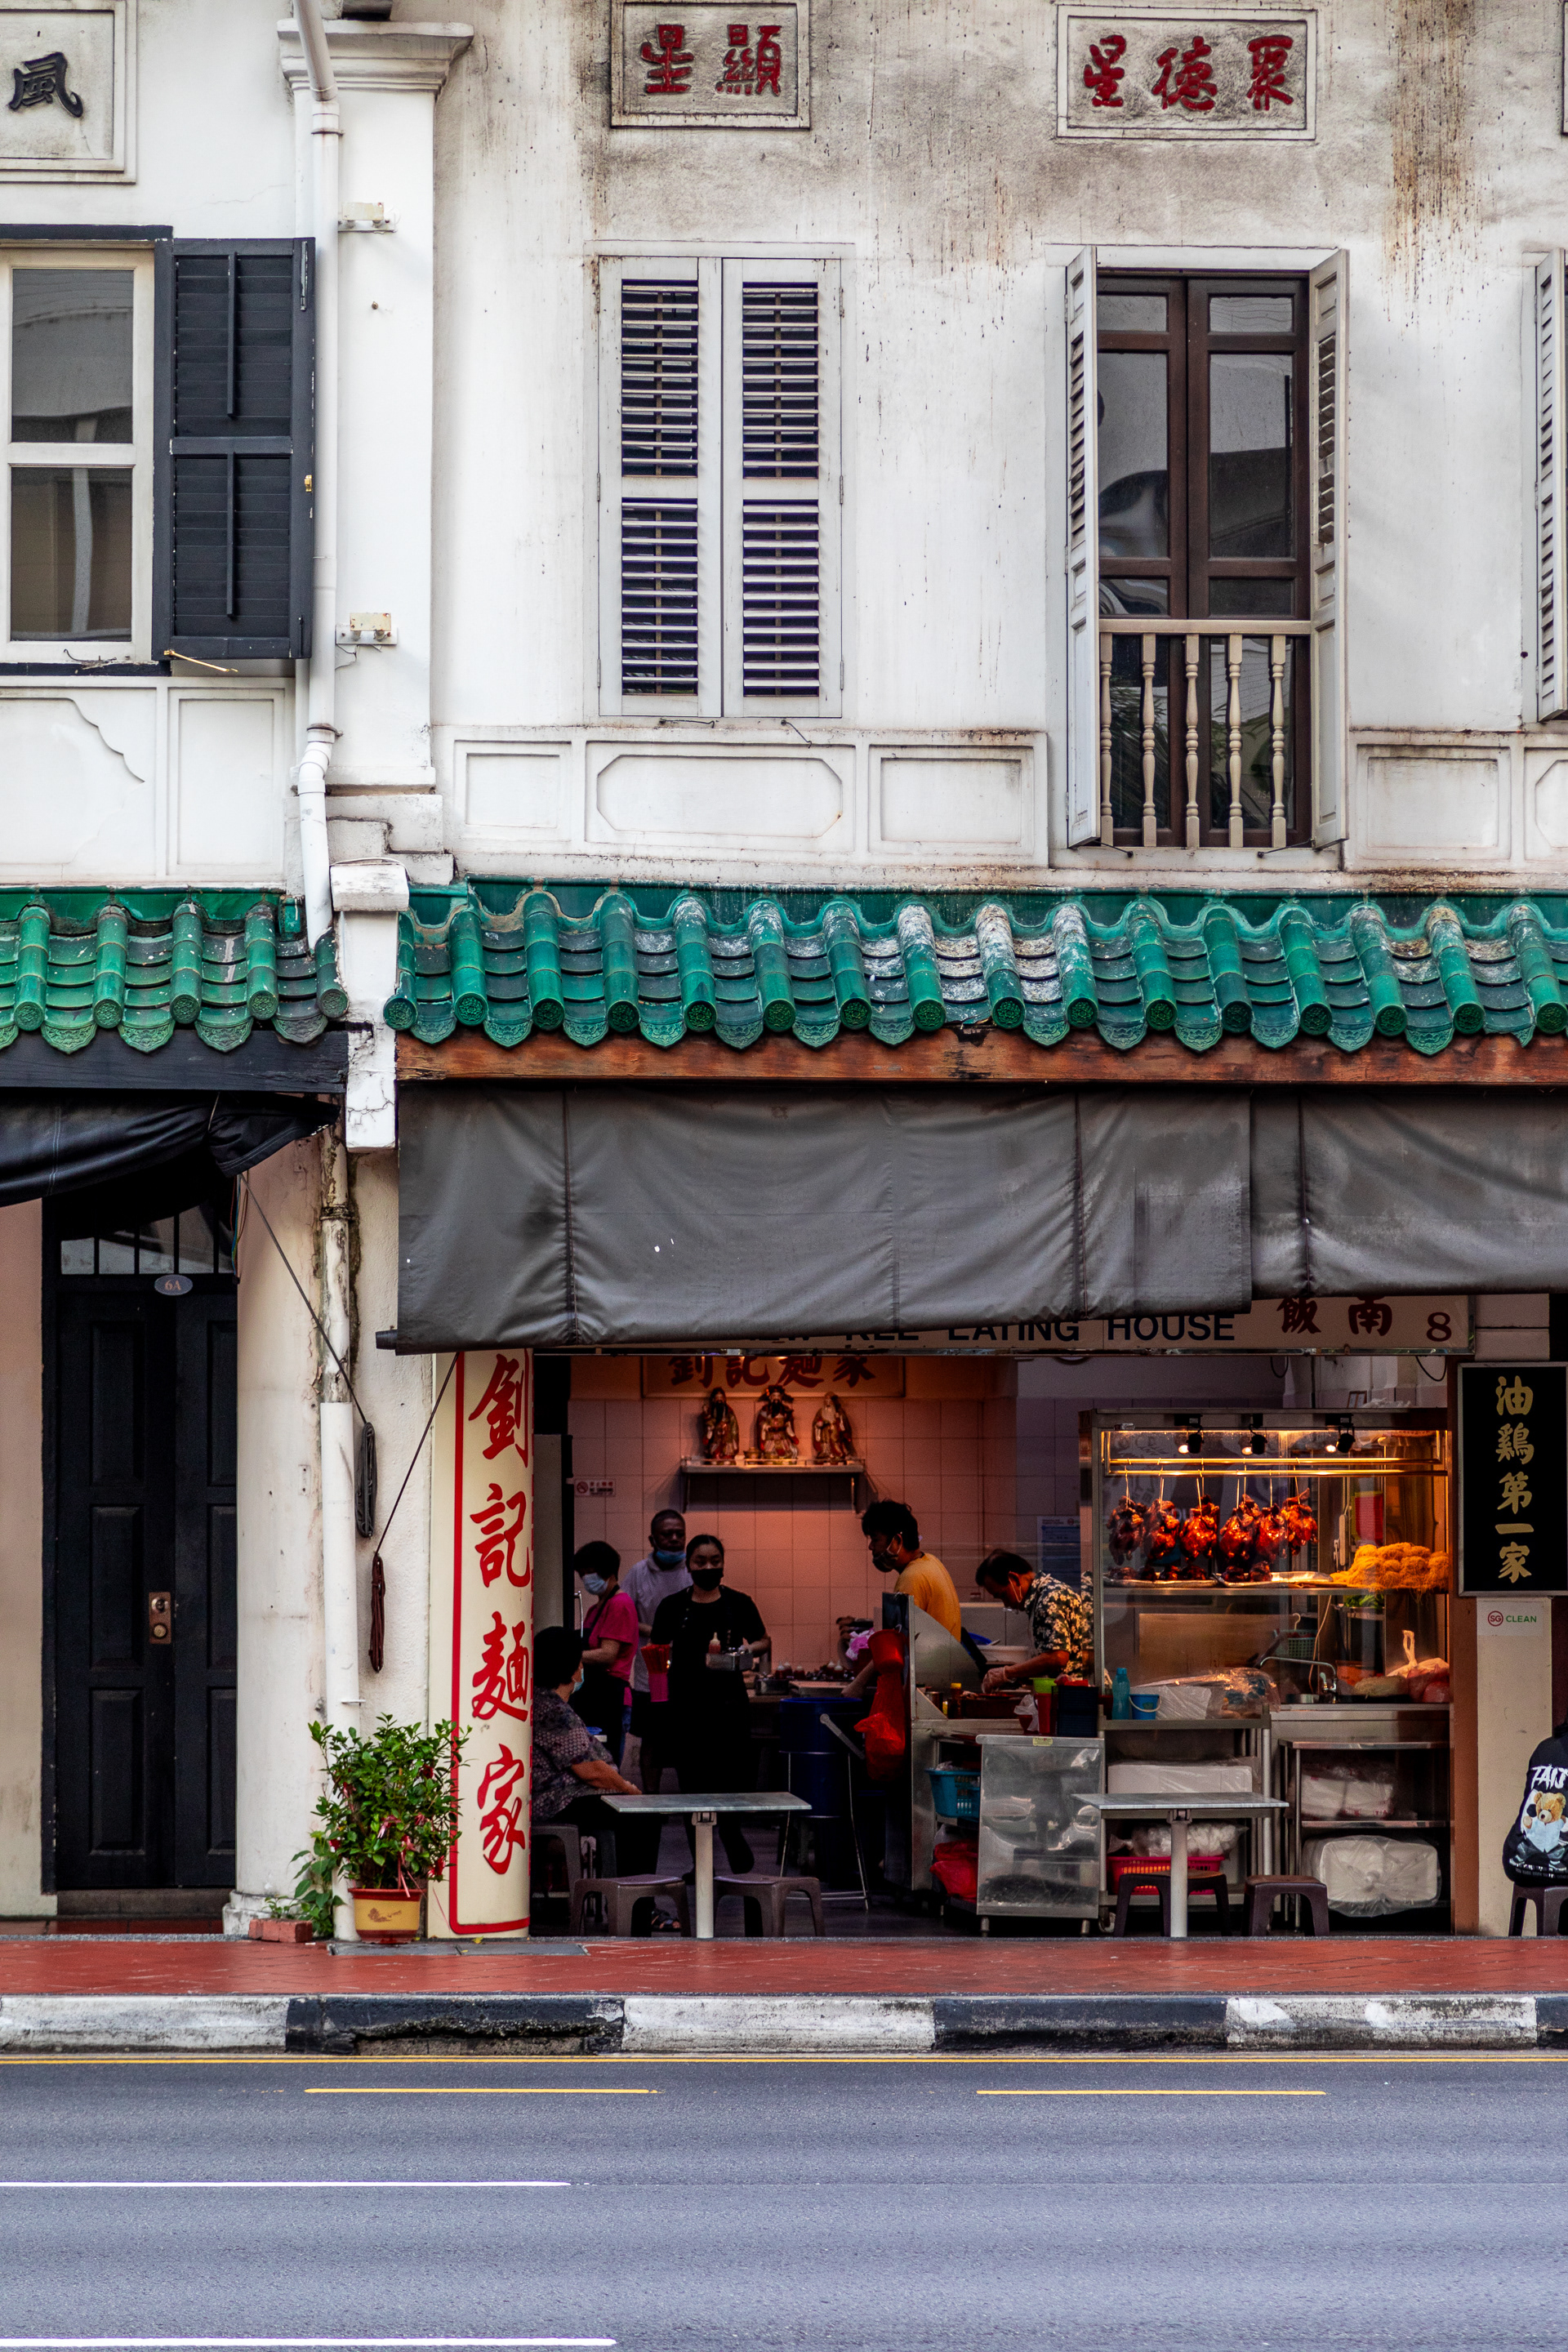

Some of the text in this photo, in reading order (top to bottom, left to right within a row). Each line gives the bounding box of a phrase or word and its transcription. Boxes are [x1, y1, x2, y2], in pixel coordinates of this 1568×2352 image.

[8, 51, 83, 118] 風
[164, 1279, 181, 1290] 6A
[1108, 1312, 1235, 1341] HOUSE
[1427, 1312, 1452, 1342] 8
[1505, 1615, 1537, 1623] CLEAN
